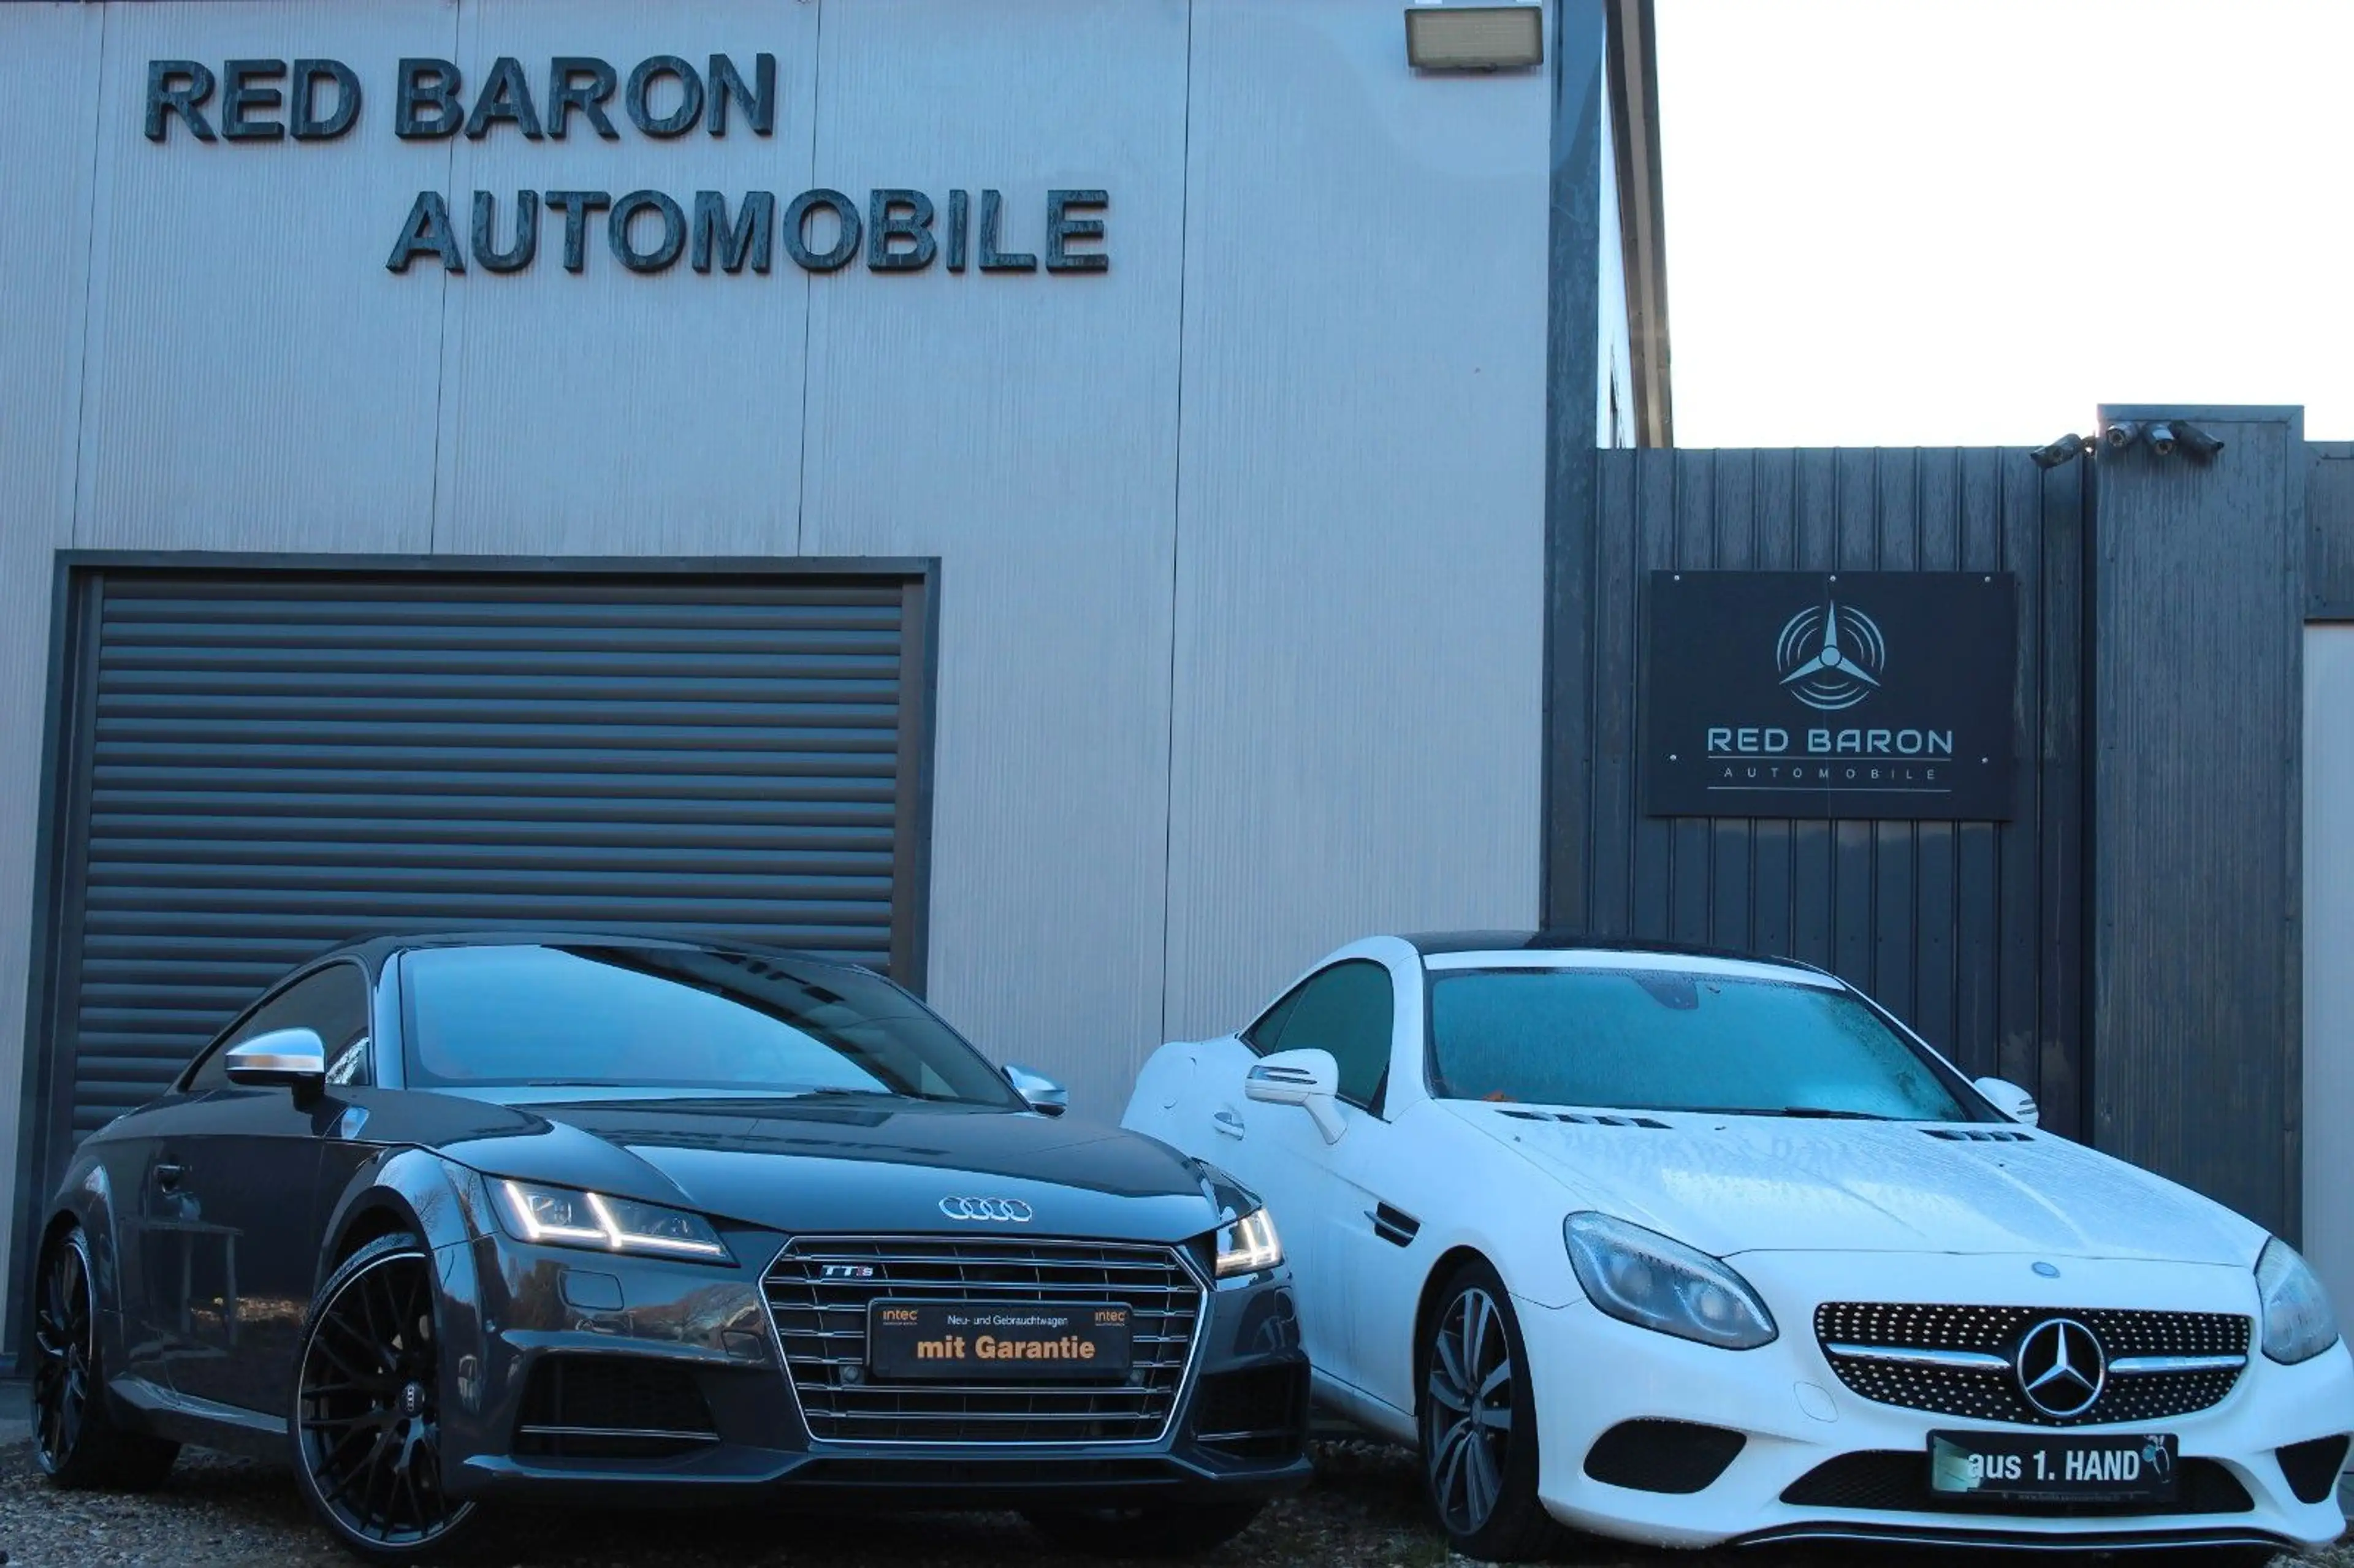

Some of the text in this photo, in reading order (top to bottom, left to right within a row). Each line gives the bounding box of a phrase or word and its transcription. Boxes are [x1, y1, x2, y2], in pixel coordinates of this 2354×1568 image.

[145, 53, 777, 142] RED BARON
[385, 188, 1110, 274] AUTOMOBILE
[1707, 728, 1952, 754] RED BARON
[1724, 766, 1935, 780] AUTOMOBILE
[947, 1315, 1068, 1328] Neu- und Gebrauchtwagen
[917, 1335, 1095, 1359] mit Garantie
[1967, 1450, 2141, 1481] aus 1. HAND
